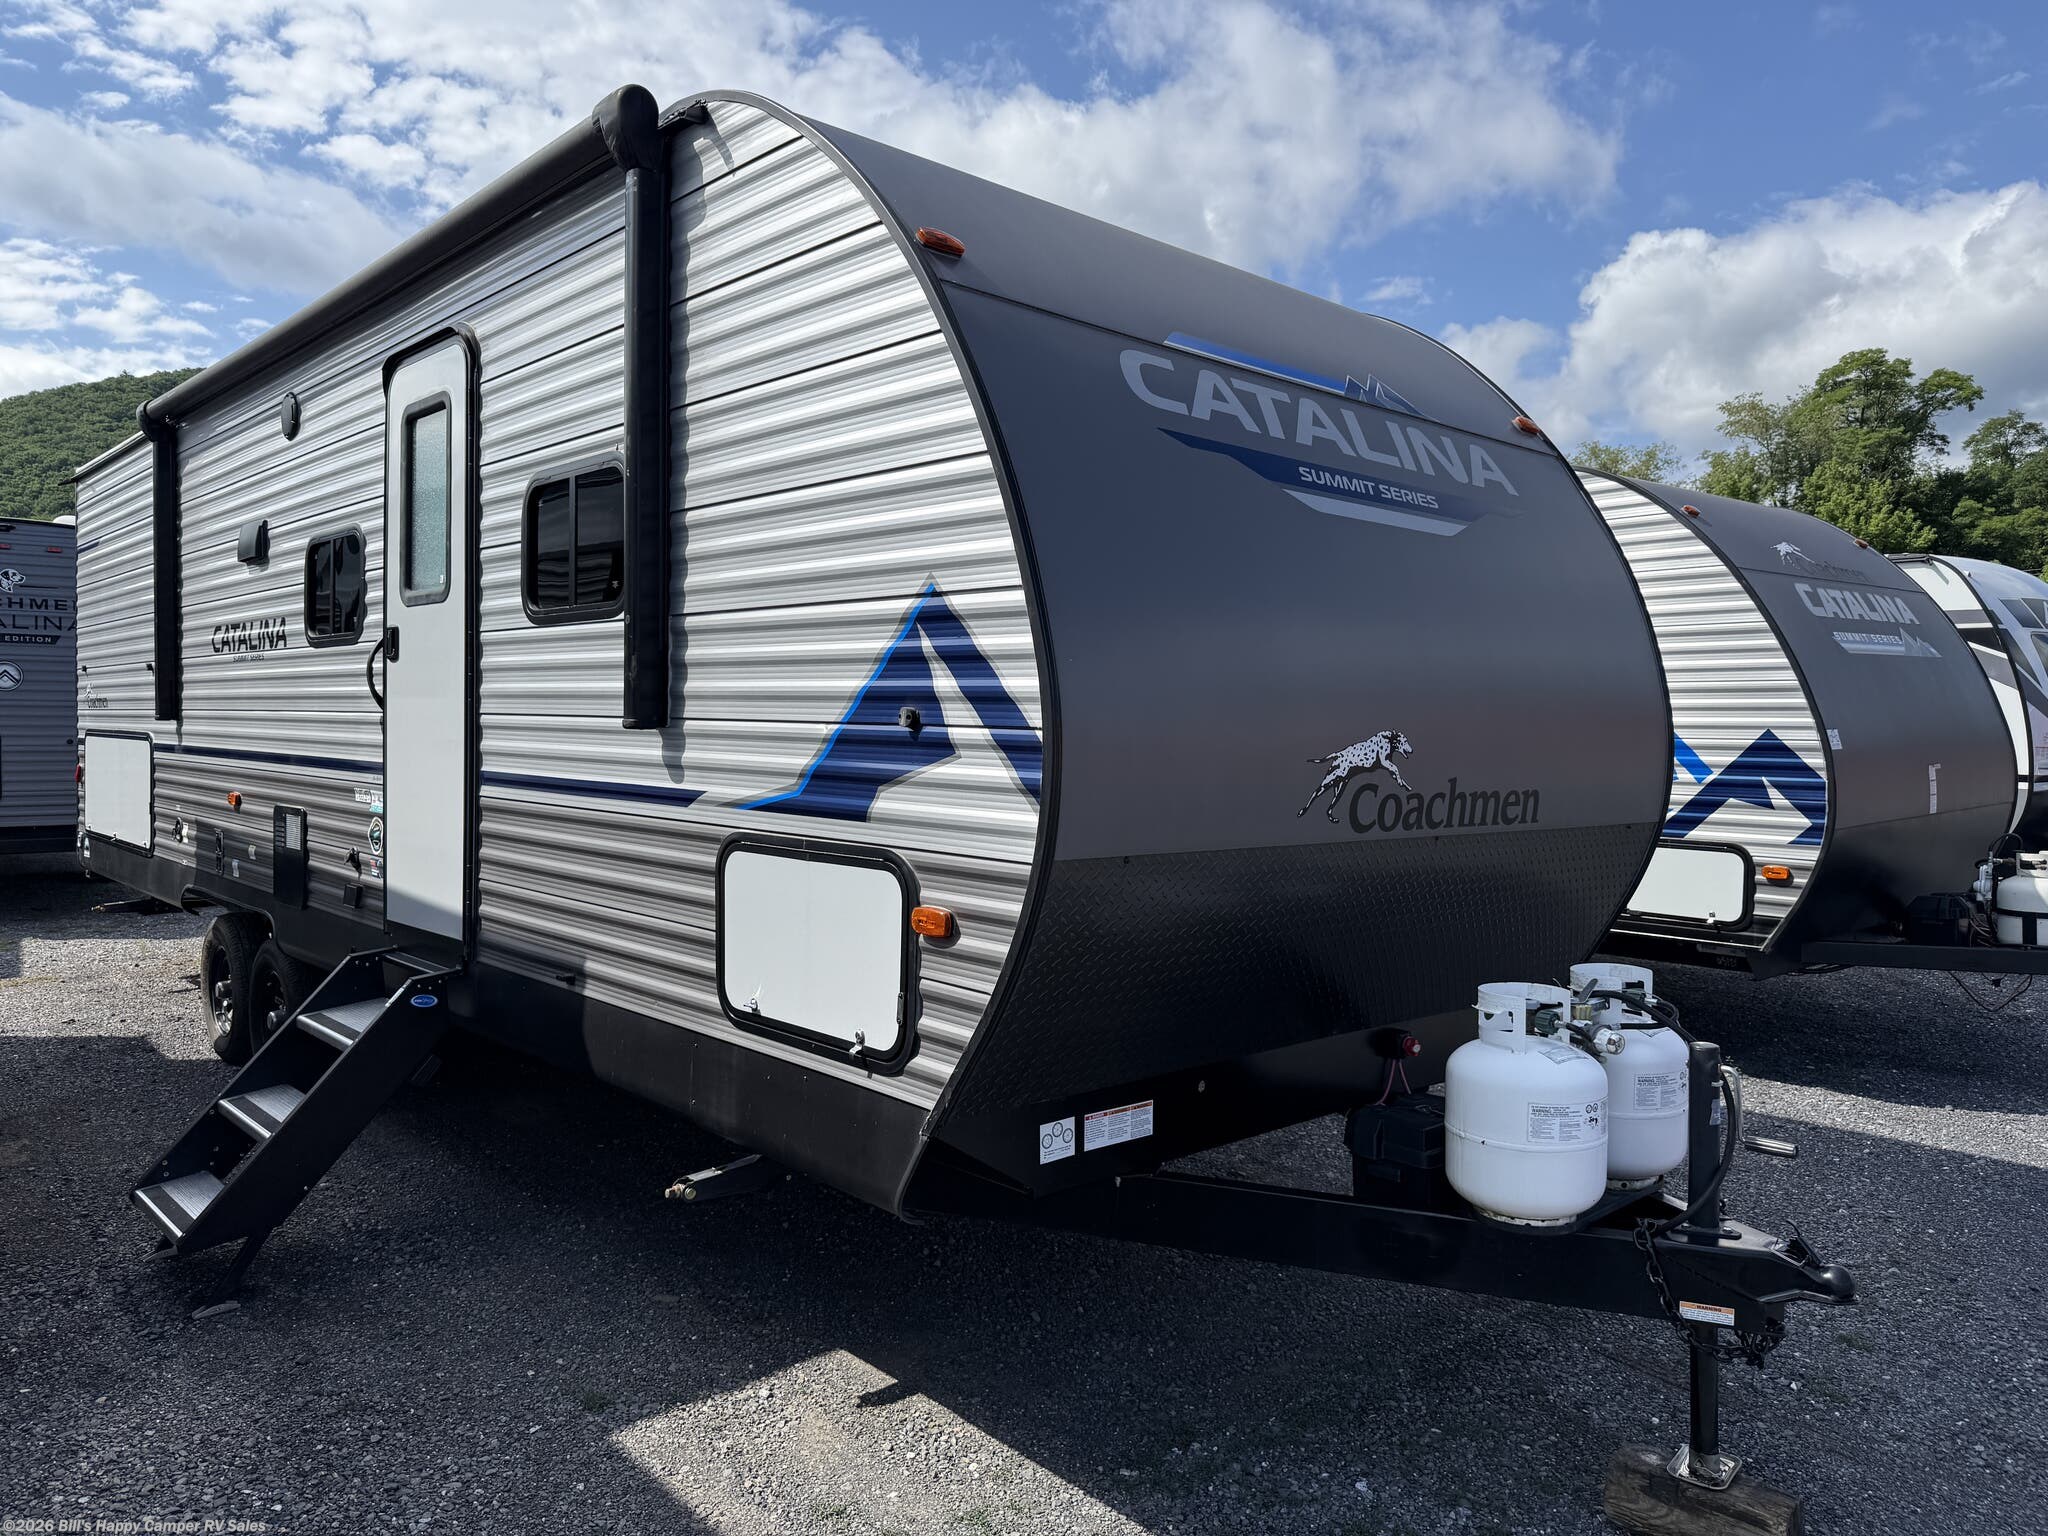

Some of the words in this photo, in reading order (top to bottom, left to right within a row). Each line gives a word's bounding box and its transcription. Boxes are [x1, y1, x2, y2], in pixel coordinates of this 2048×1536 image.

[1119, 349, 1519, 496] CATALINA
[1298, 466, 1376, 497] SUMMIT
[1378, 484, 1440, 509] SERIES
[1793, 582, 1921, 625] CATALINA
[4, 635, 52, 643] EDITION
[211, 616, 287, 653] CATALINA
[1832, 631, 1868, 643] SUMMIT
[1872, 633, 1903, 645] SERIES
[1350, 776, 1540, 834] Coachmen
